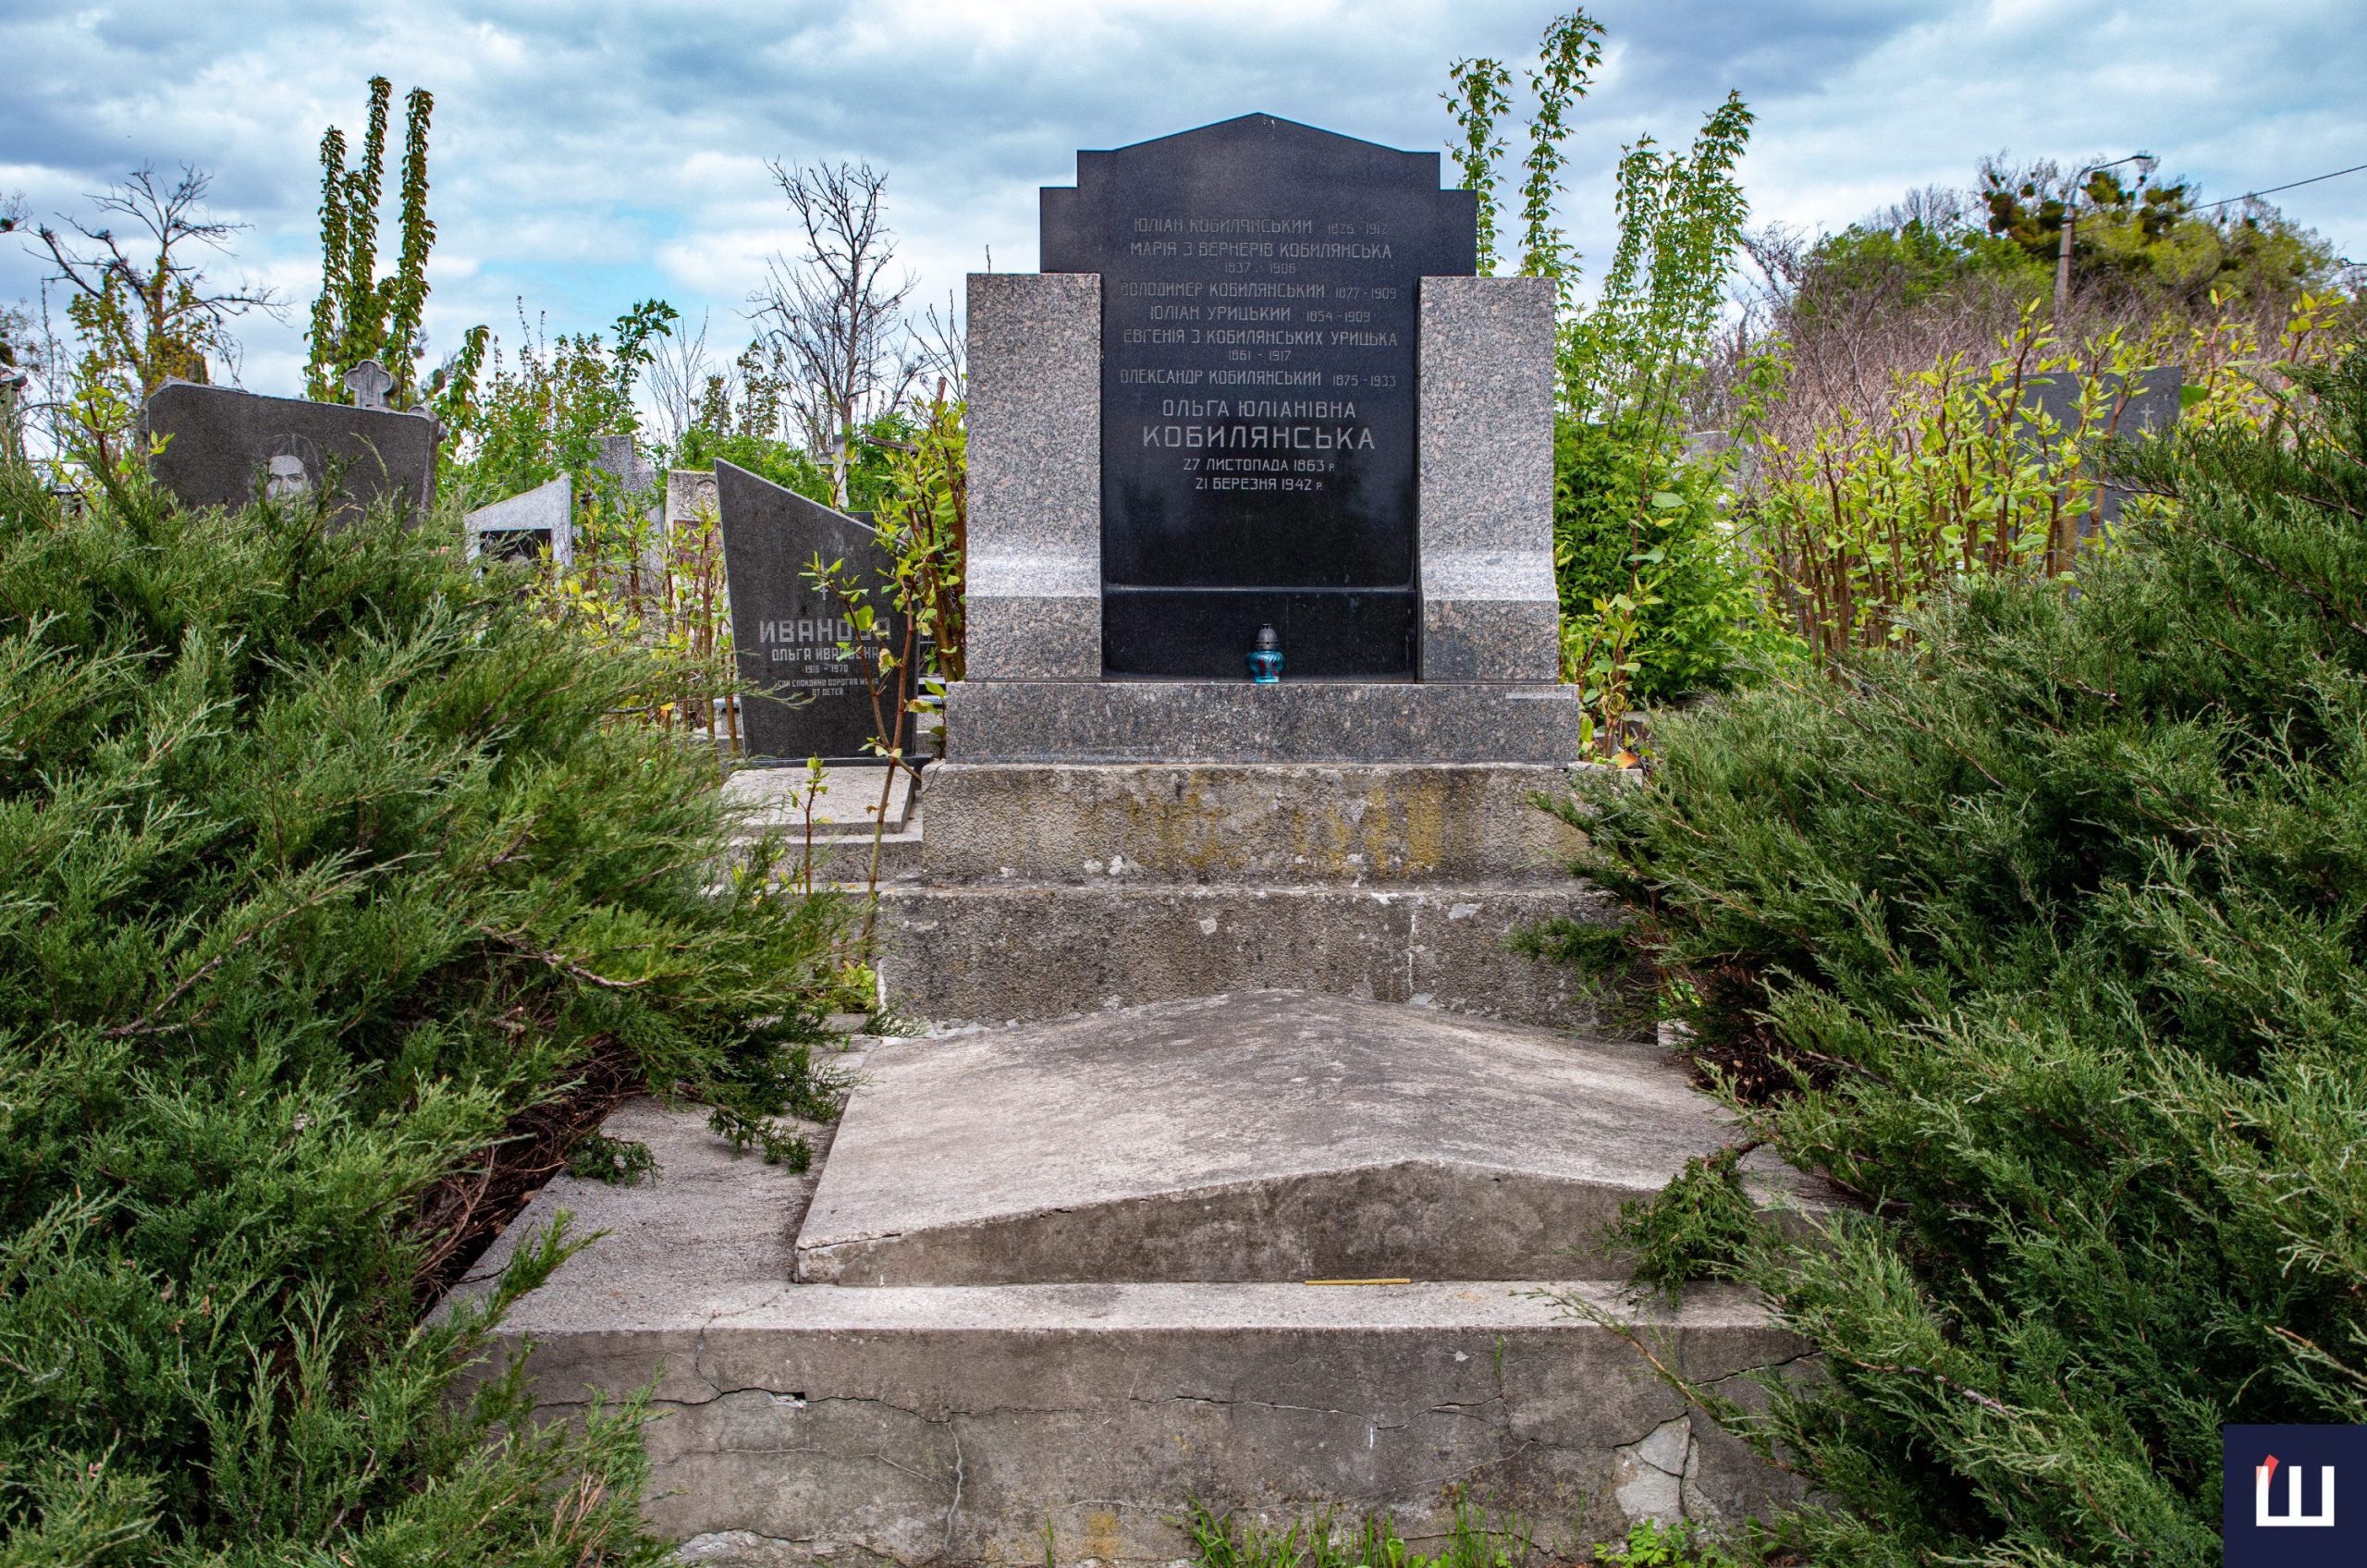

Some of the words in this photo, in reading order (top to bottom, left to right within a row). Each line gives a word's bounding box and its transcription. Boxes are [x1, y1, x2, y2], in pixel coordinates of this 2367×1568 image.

[1134, 217, 1184, 232] ЮЛІАН
[1130, 241, 1177, 256] МАРІЯ
[1198, 241, 1273, 257] ВЕРНЕРІВ
[1280, 242, 1392, 259] КОБИЛЯНСЬКА
[1225, 262, 1251, 274] 1837
[1269, 263, 1296, 274] 1906
[1121, 281, 1203, 297] ВОЛОДИМЕР
[1209, 281, 1326, 298] КОБИЛЯНСЬКИЙ
[1371, 288, 1397, 300] 1909
[1150, 305, 1200, 320] ЮЛІАН
[1207, 305, 1291, 321] УРИЦЬКИЙ
[1306, 311, 1333, 323] 1854
[1344, 311, 1371, 323] 1909
[1123, 328, 1184, 344] ЕВГЕНІЯ
[1207, 330, 1323, 346] КОБИЛЯНСЬКИХ
[1331, 331, 1398, 347] УРИЦЬКА
[1228, 349, 1251, 361] 1861
[1269, 349, 1292, 361] 1917
[1120, 369, 1203, 385] ОЛЕКСАНДР
[1209, 369, 1321, 386] КОБИЛЯНСЬКИЙ
[1332, 374, 1358, 386] 1875
[1370, 375, 1396, 387] 1933
[1162, 399, 1230, 417] ОЛЬГА
[1238, 400, 1356, 418] ЮЛІАНІВНА
[1142, 425, 1376, 449] КОБИЛЯНСЬКА
[1184, 458, 1200, 471] 27
[1206, 459, 1289, 472] ЛИСТОПАДА
[1294, 459, 1325, 472] 1863
[1196, 478, 1208, 490] 21
[1212, 478, 1277, 490] БЕРЕЗНЯ
[1282, 478, 1313, 491] 1942
[772, 647, 812, 661] ОЛЬГА
